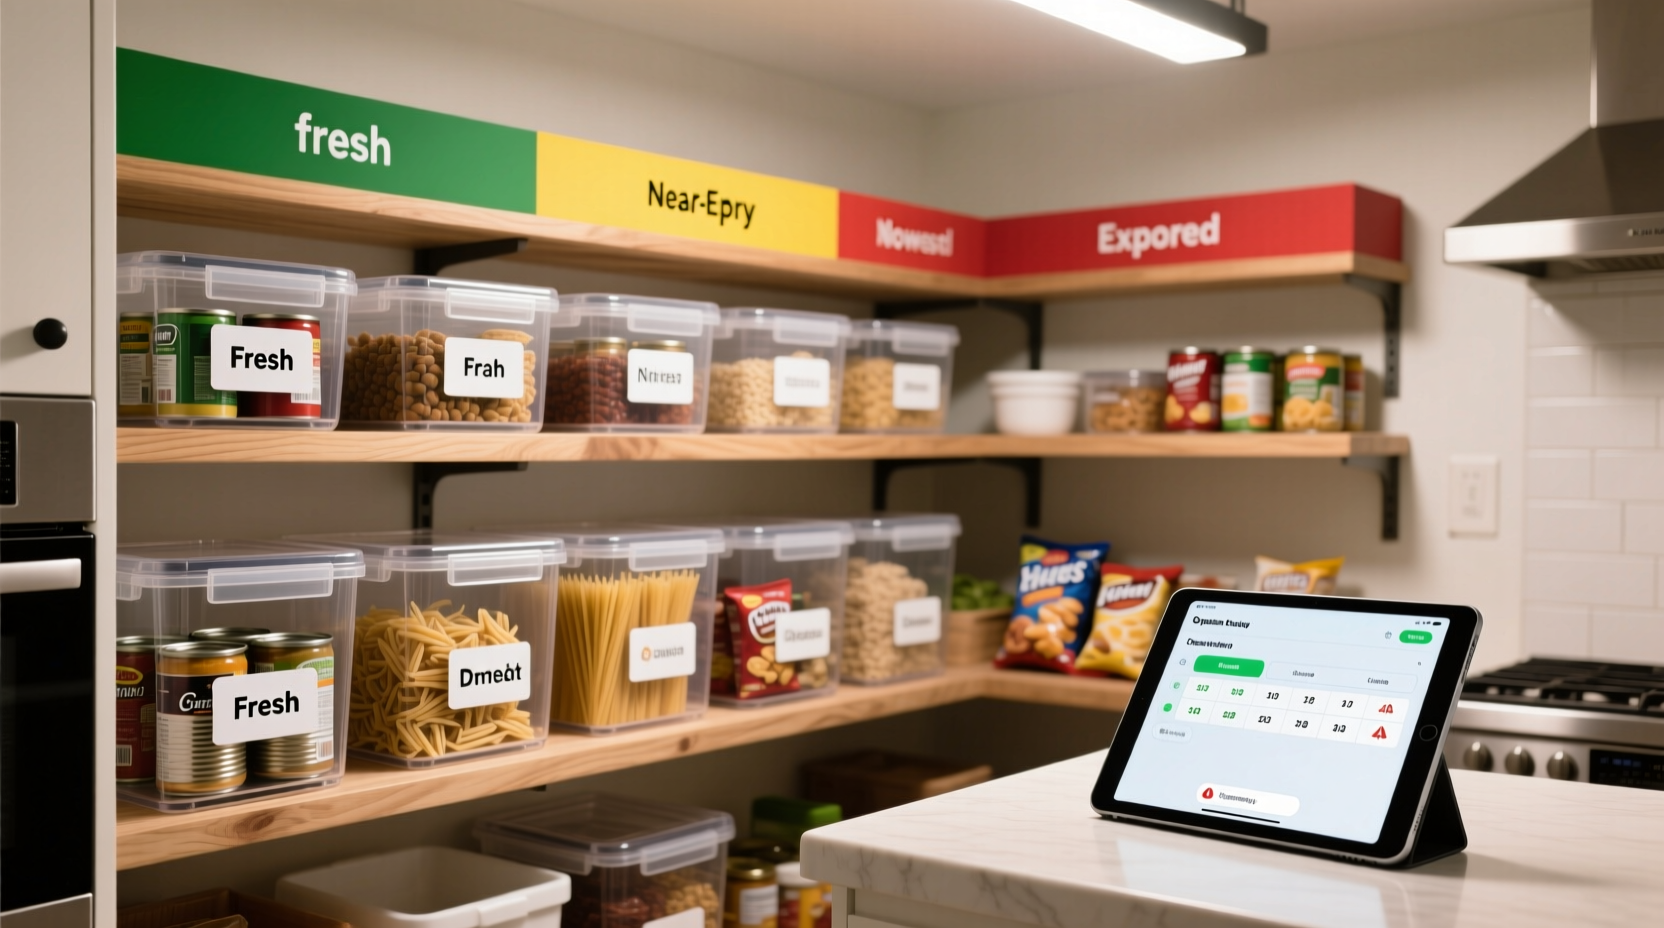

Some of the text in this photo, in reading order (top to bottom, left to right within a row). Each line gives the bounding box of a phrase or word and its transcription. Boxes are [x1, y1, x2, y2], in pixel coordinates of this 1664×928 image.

[294, 112, 391, 166] fresh
[648, 180, 756, 229] Near-Epry
[1097, 212, 1221, 259] Expored
[230, 345, 294, 371] Fresh
[464, 357, 505, 378] Frah
[234, 690, 300, 720] Fresh
